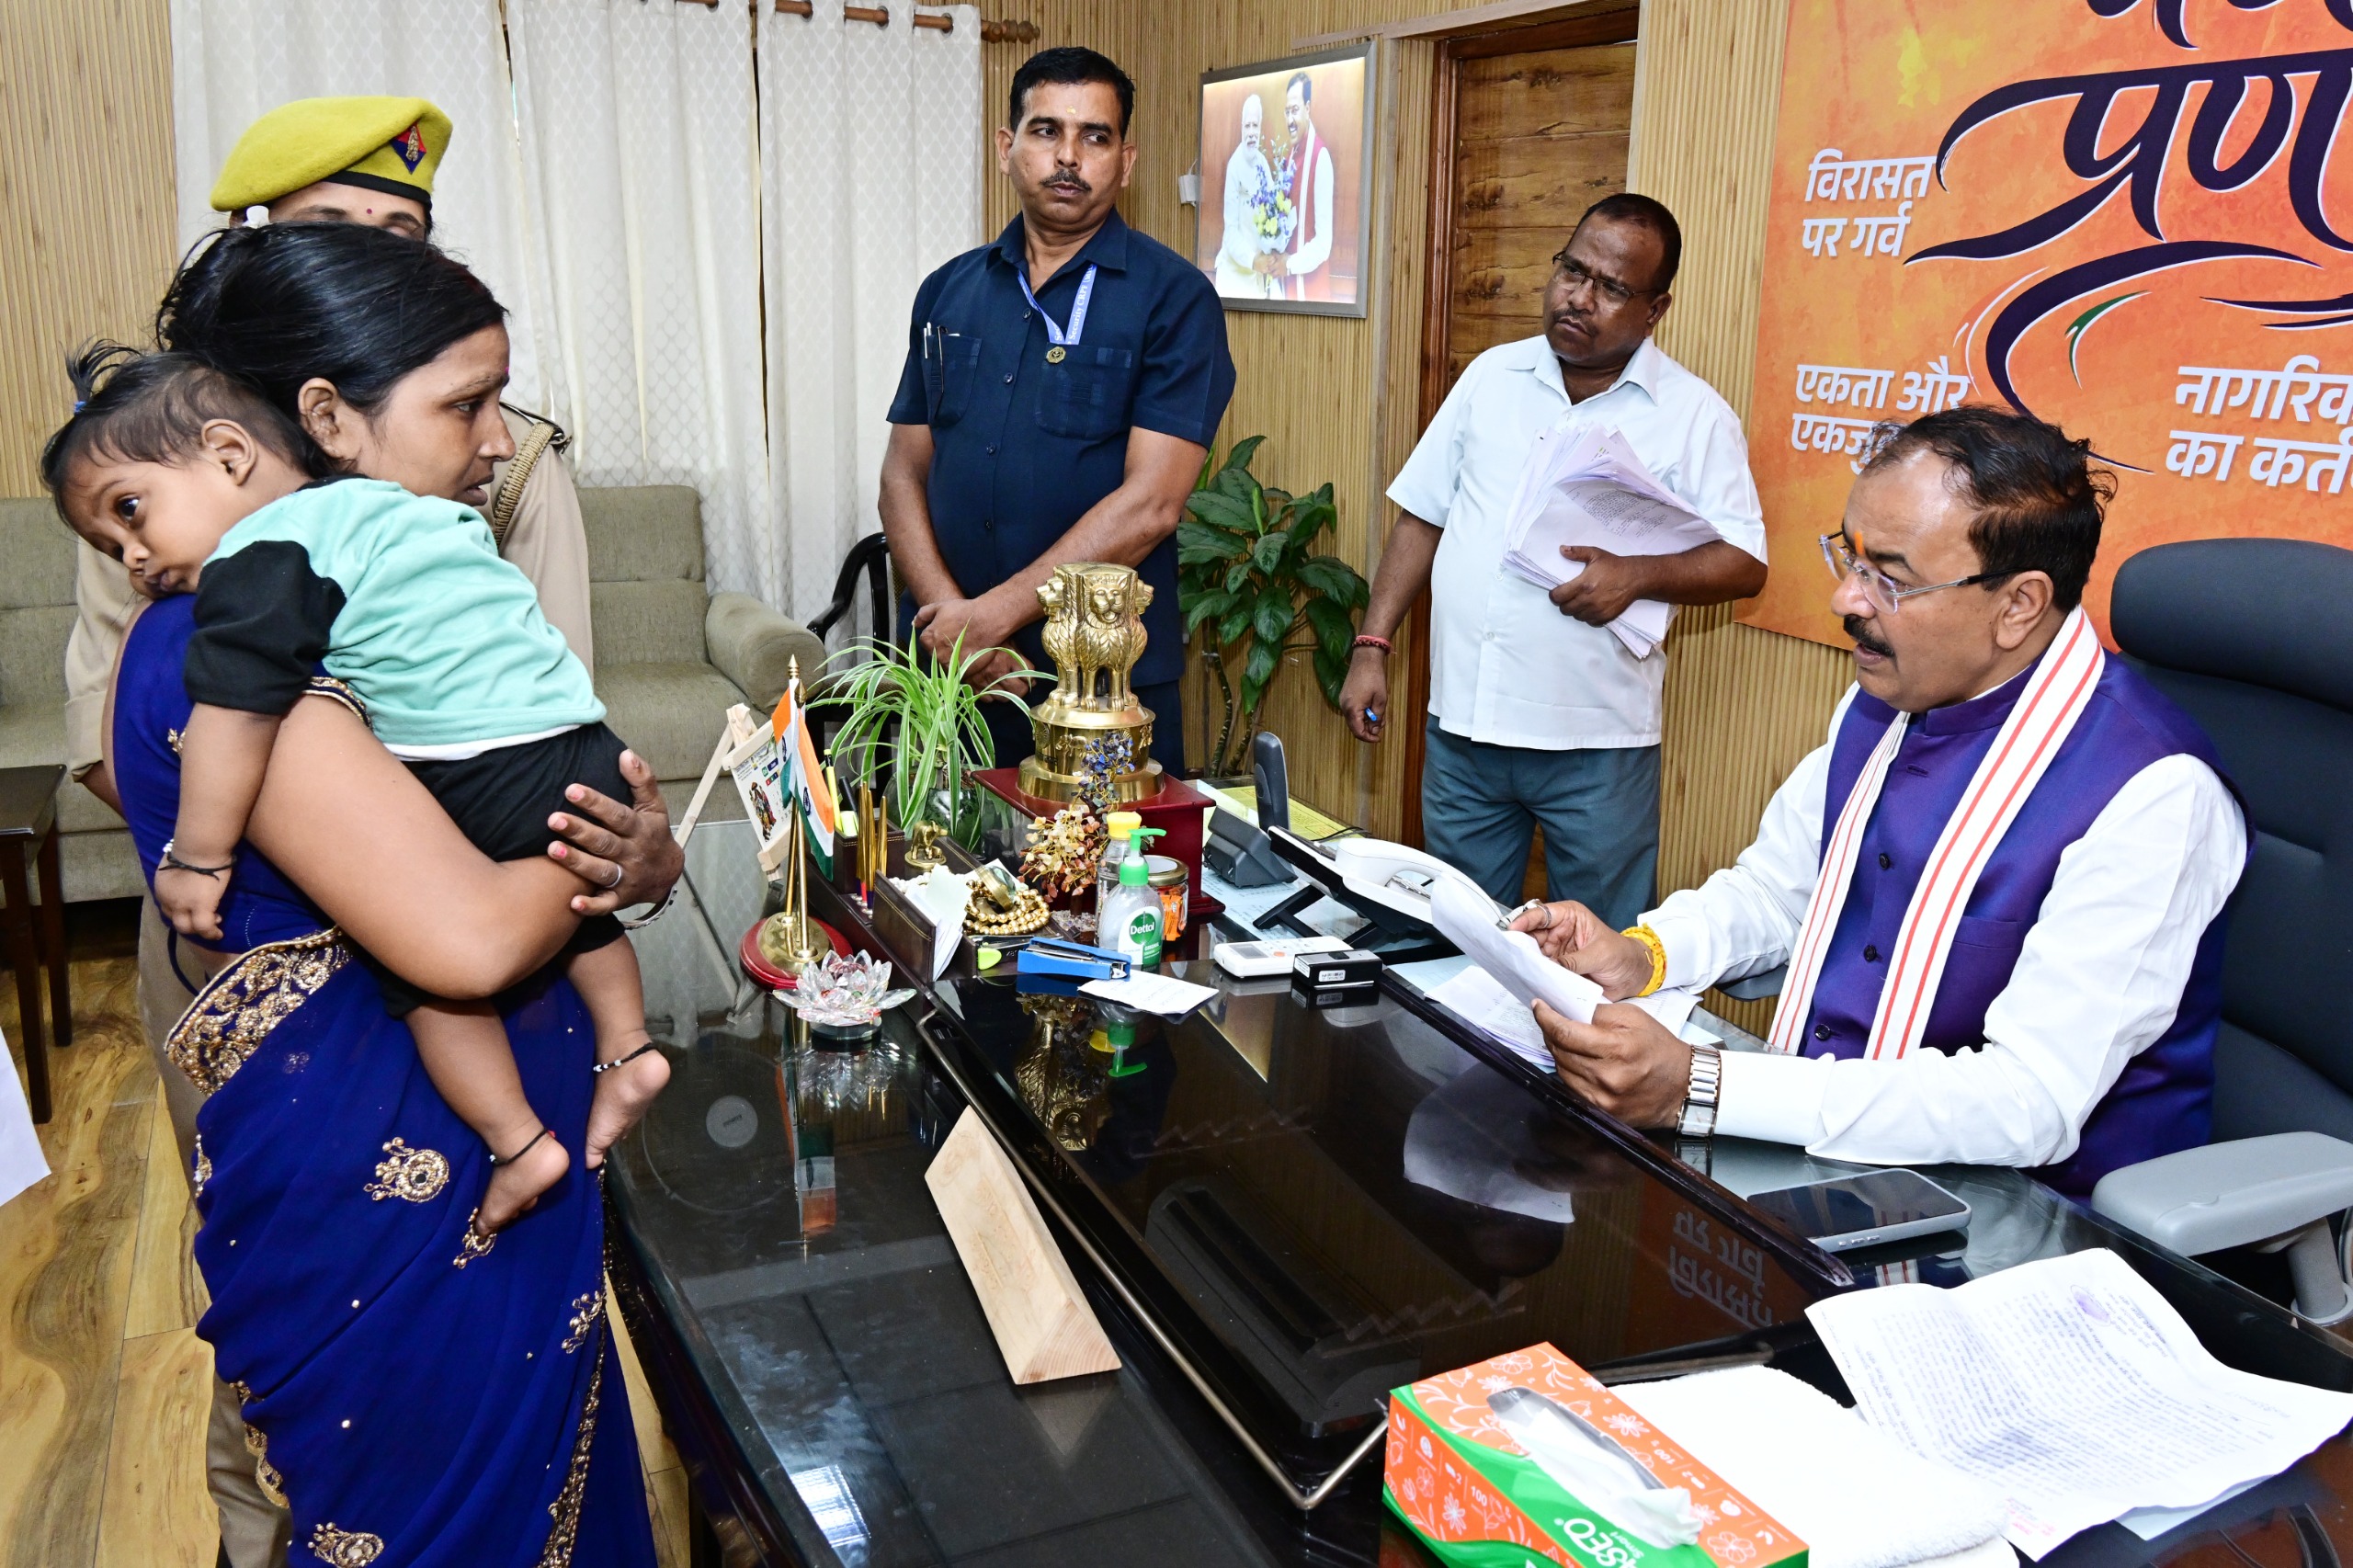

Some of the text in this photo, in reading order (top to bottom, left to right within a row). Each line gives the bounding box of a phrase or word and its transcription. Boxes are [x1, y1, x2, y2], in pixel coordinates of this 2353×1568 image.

[1804, 148, 1937, 201] विरासत
[1802, 200, 1913, 256] पर गर्व
[1069, 307, 1084, 339] Security
[1077, 285, 1087, 305] CRPF
[1795, 356, 1971, 414] एकता और
[2165, 426, 2353, 494] का कर्त
[1130, 922, 1154, 935] Dettol
[1654, 1449, 1676, 1465] 100
[1471, 1485, 1488, 1506] 100
